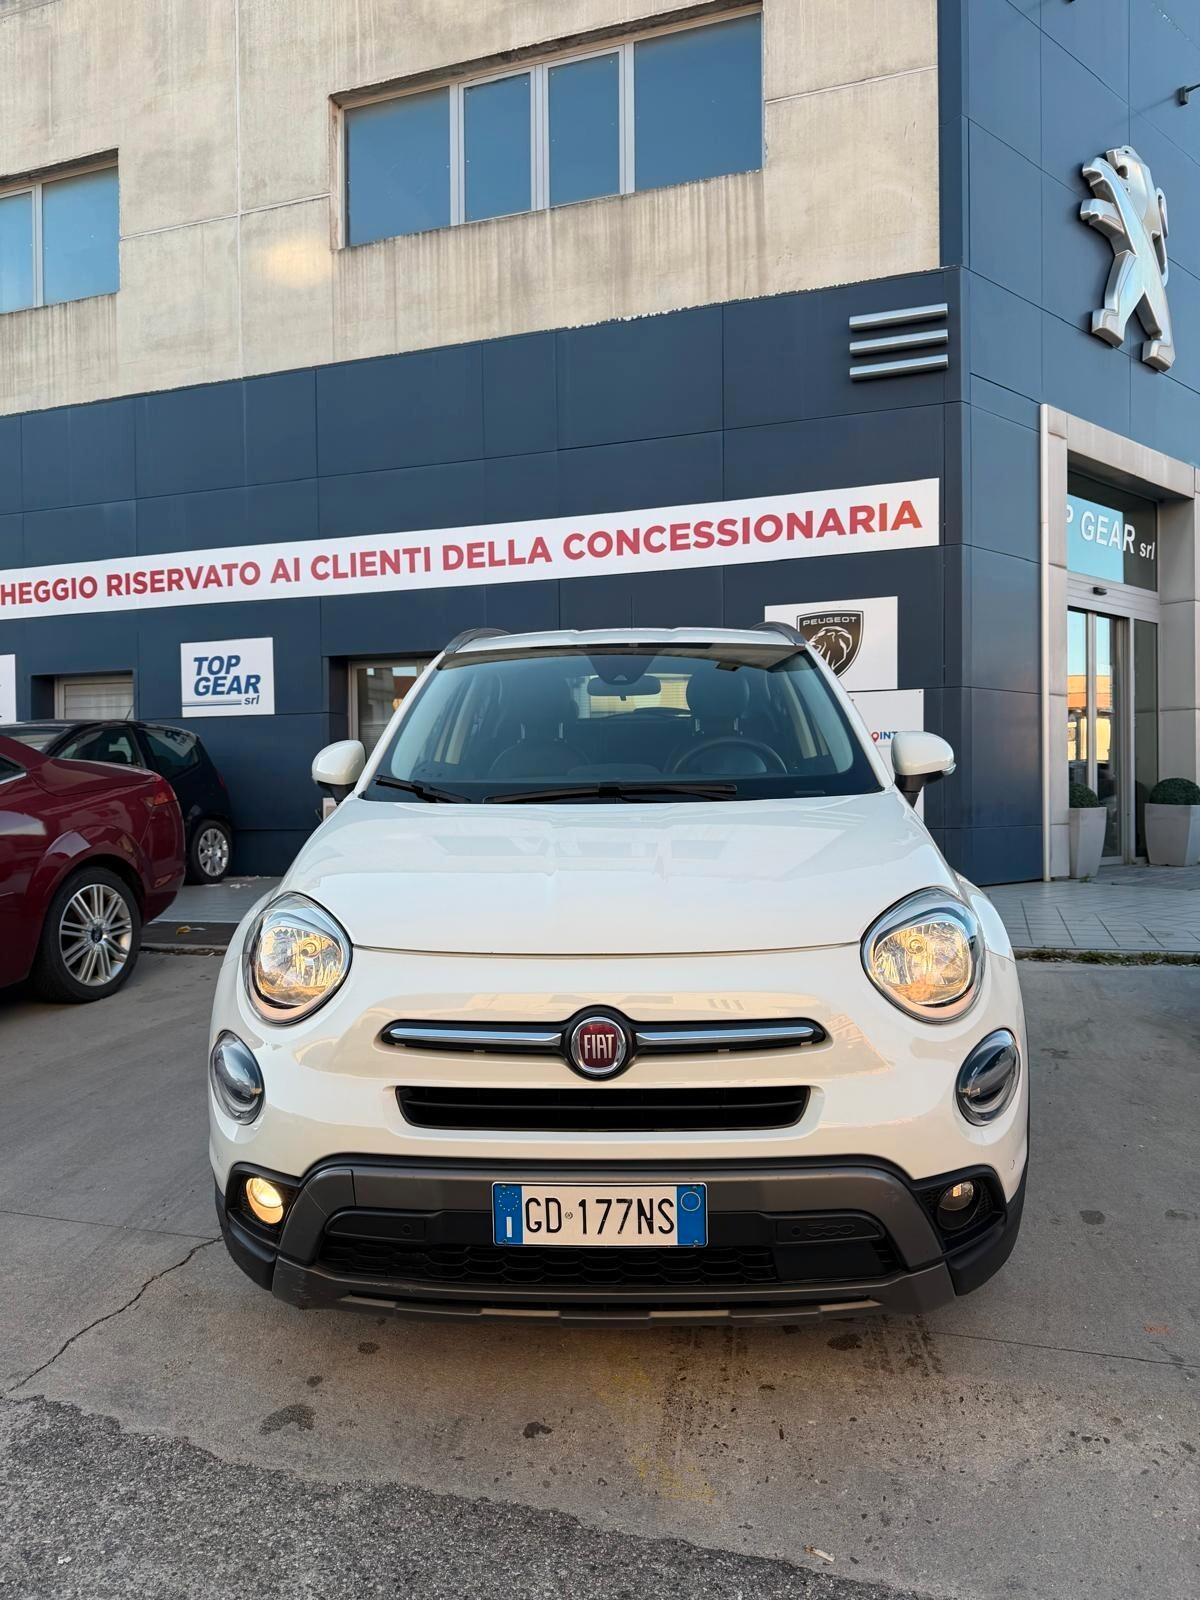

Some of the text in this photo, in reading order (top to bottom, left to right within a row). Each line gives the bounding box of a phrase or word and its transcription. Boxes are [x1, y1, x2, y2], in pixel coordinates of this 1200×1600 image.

[1081, 510, 1136, 554] GEAR
[1139, 541, 1156, 560] srl
[0, 500, 922, 606] HEGGIO RISERVATO AI CLIENTI DELLA CONCESSIONARIA
[802, 616, 857, 626] PEUGEOT
[193, 655, 241, 676] TOP
[194, 674, 262, 697] GEAR
[243, 695, 260, 705] srl
[583, 1034, 615, 1060] FIAT
[525, 1197, 563, 1234] GD
[578, 1197, 675, 1235] 177NS
